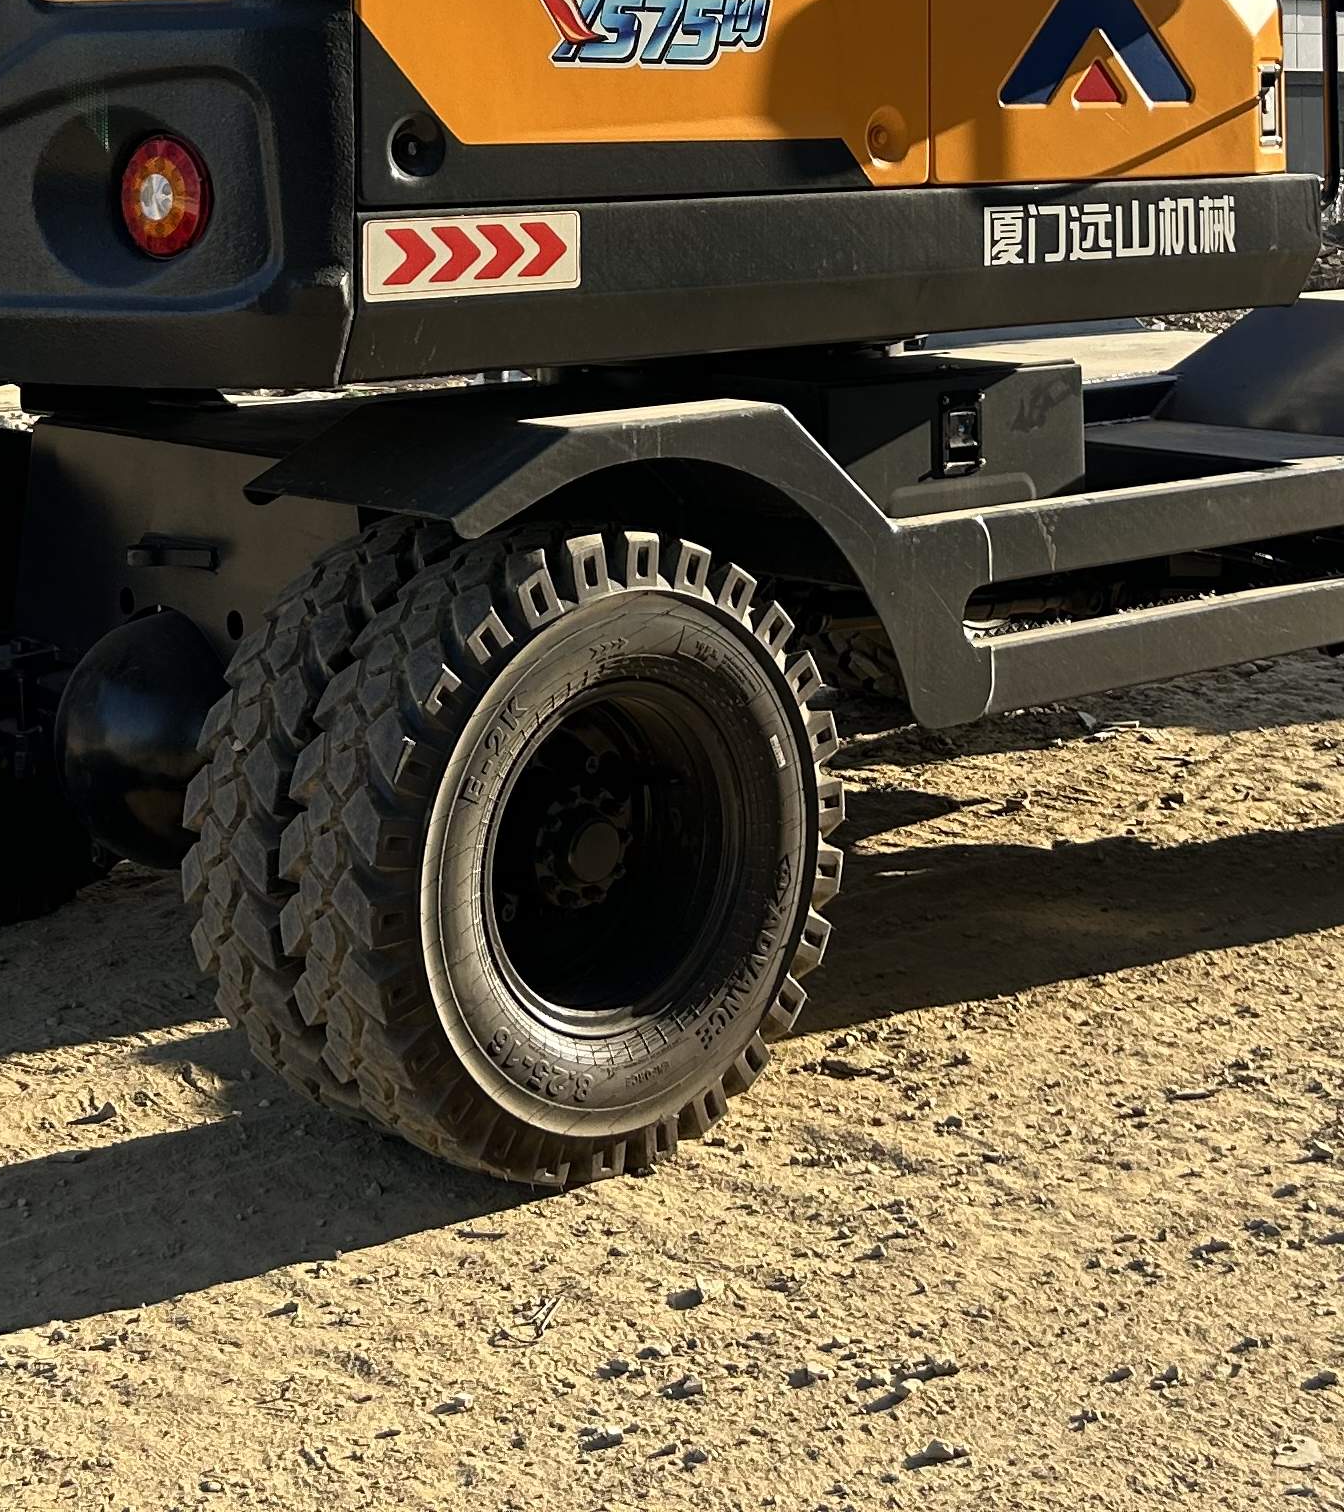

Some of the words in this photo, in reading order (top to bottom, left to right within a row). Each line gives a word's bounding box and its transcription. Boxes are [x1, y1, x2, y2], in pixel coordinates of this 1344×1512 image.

[983, 194, 1237, 266] 厦门远山机械
[694, 896, 784, 1050] ADVANCE
[486, 1026, 595, 1103] 8.25-16
